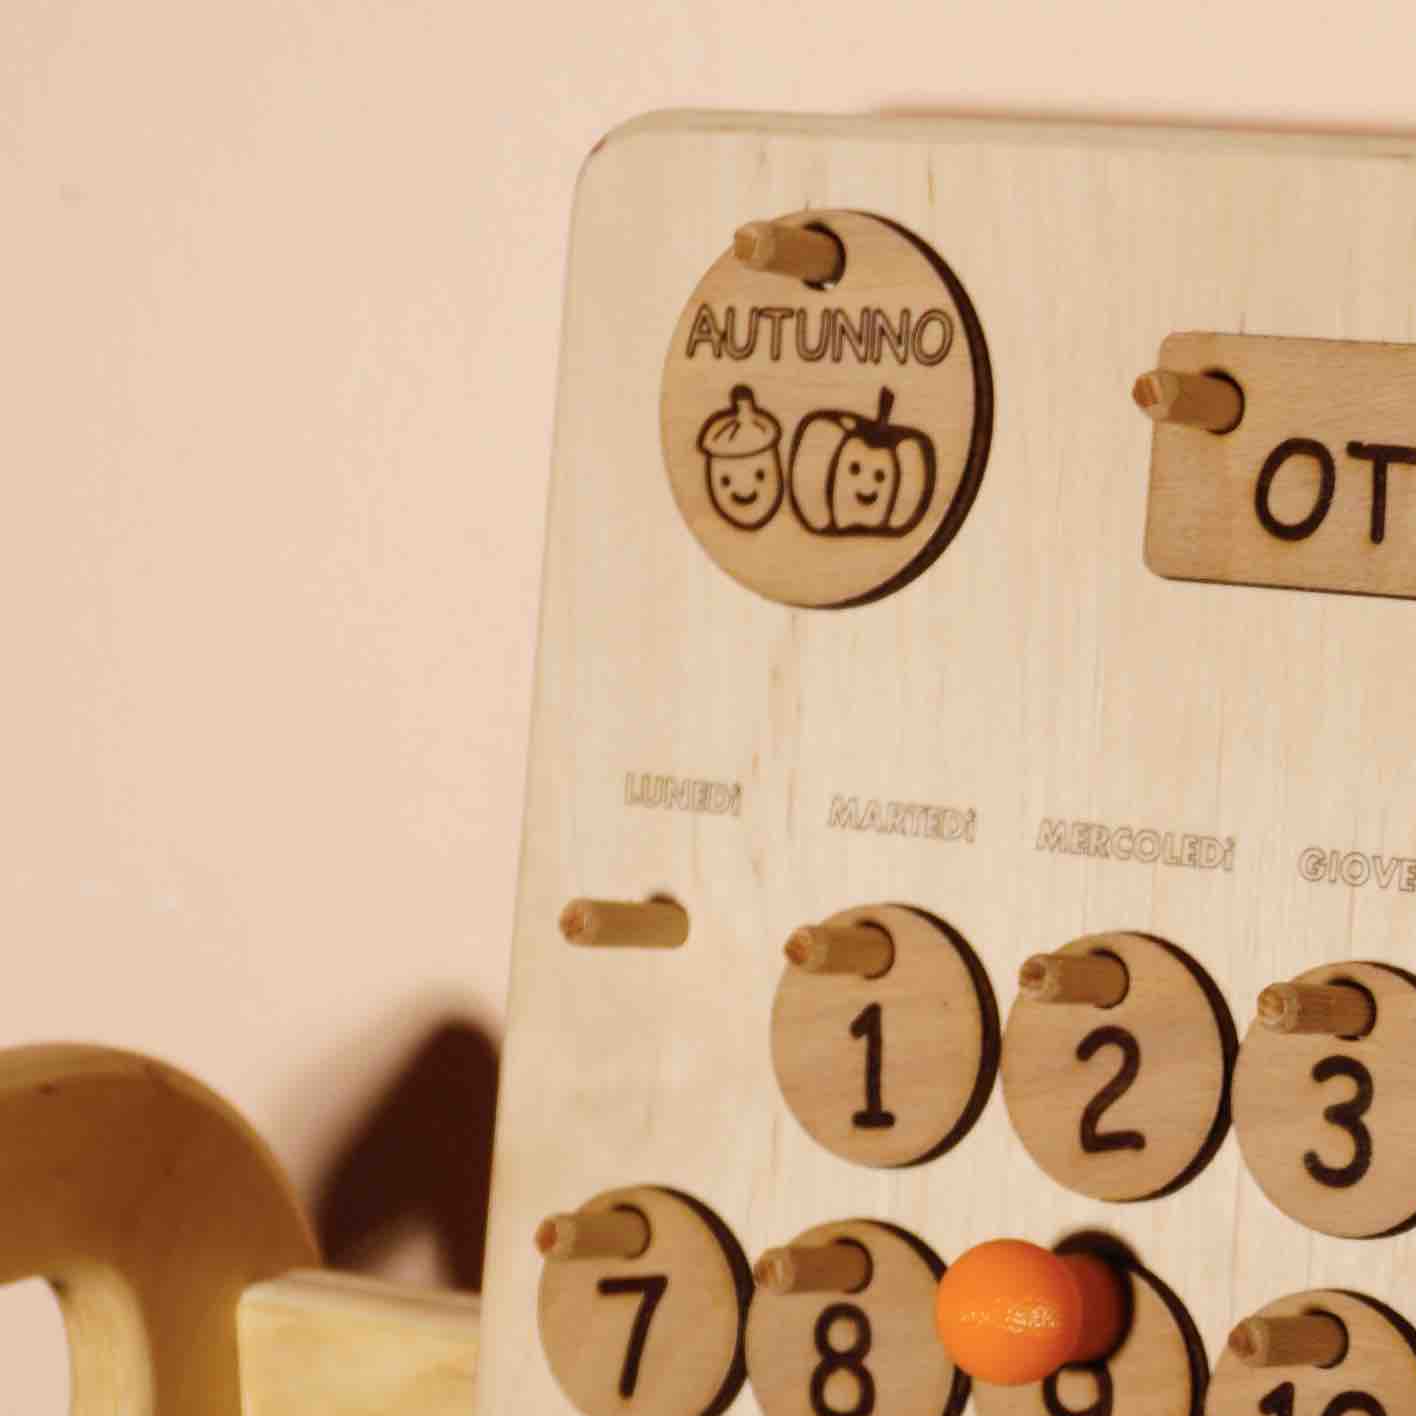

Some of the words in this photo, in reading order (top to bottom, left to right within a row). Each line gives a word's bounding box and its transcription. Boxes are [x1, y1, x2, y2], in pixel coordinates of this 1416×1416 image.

[686, 303, 954, 366] AUTUNNO
[851, 1004, 893, 1128] 1
[1076, 1026, 1146, 1152] 2
[1304, 1057, 1374, 1188] 3
[599, 1275, 667, 1398] 7
